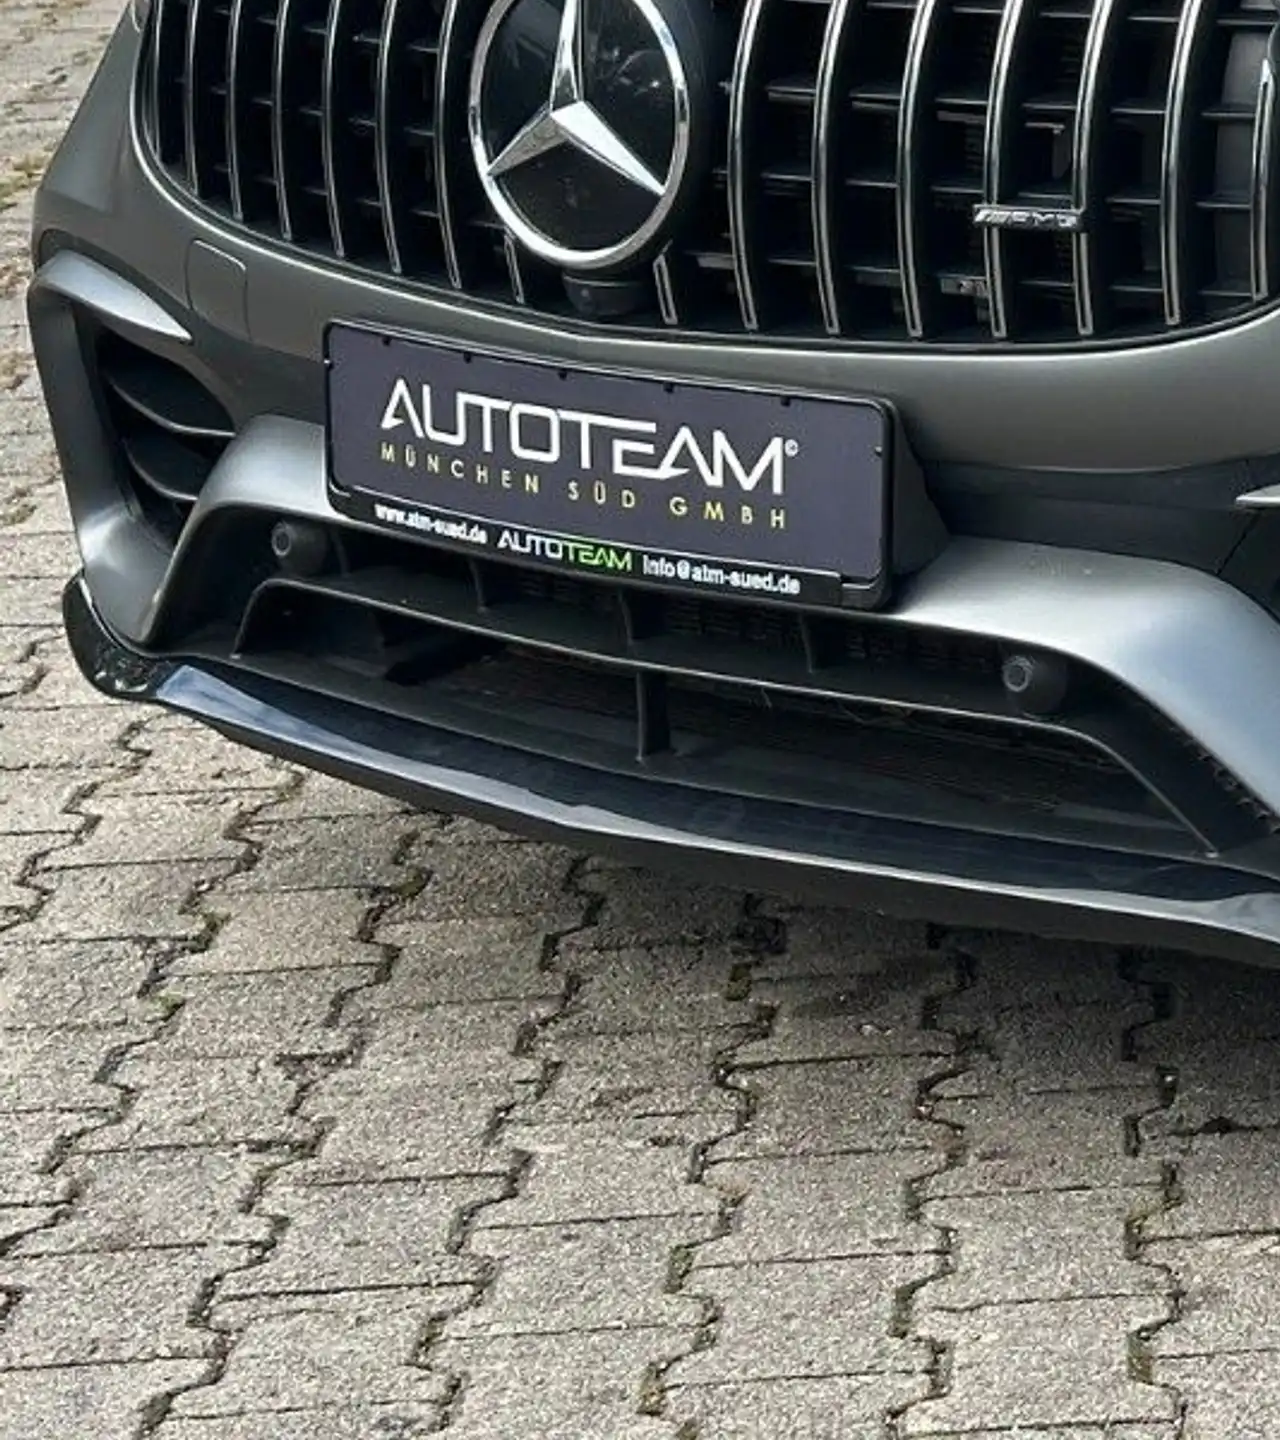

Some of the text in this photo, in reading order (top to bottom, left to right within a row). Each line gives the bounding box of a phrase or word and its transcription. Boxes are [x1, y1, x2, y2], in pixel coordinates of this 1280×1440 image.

[381, 378, 784, 496] AUTOTEAM
[381, 441, 786, 529] MÜNCHEN SÜD GMBH
[373, 503, 801, 595] www.atm-sued.de AUTOTEAM info@atm-sued.de
